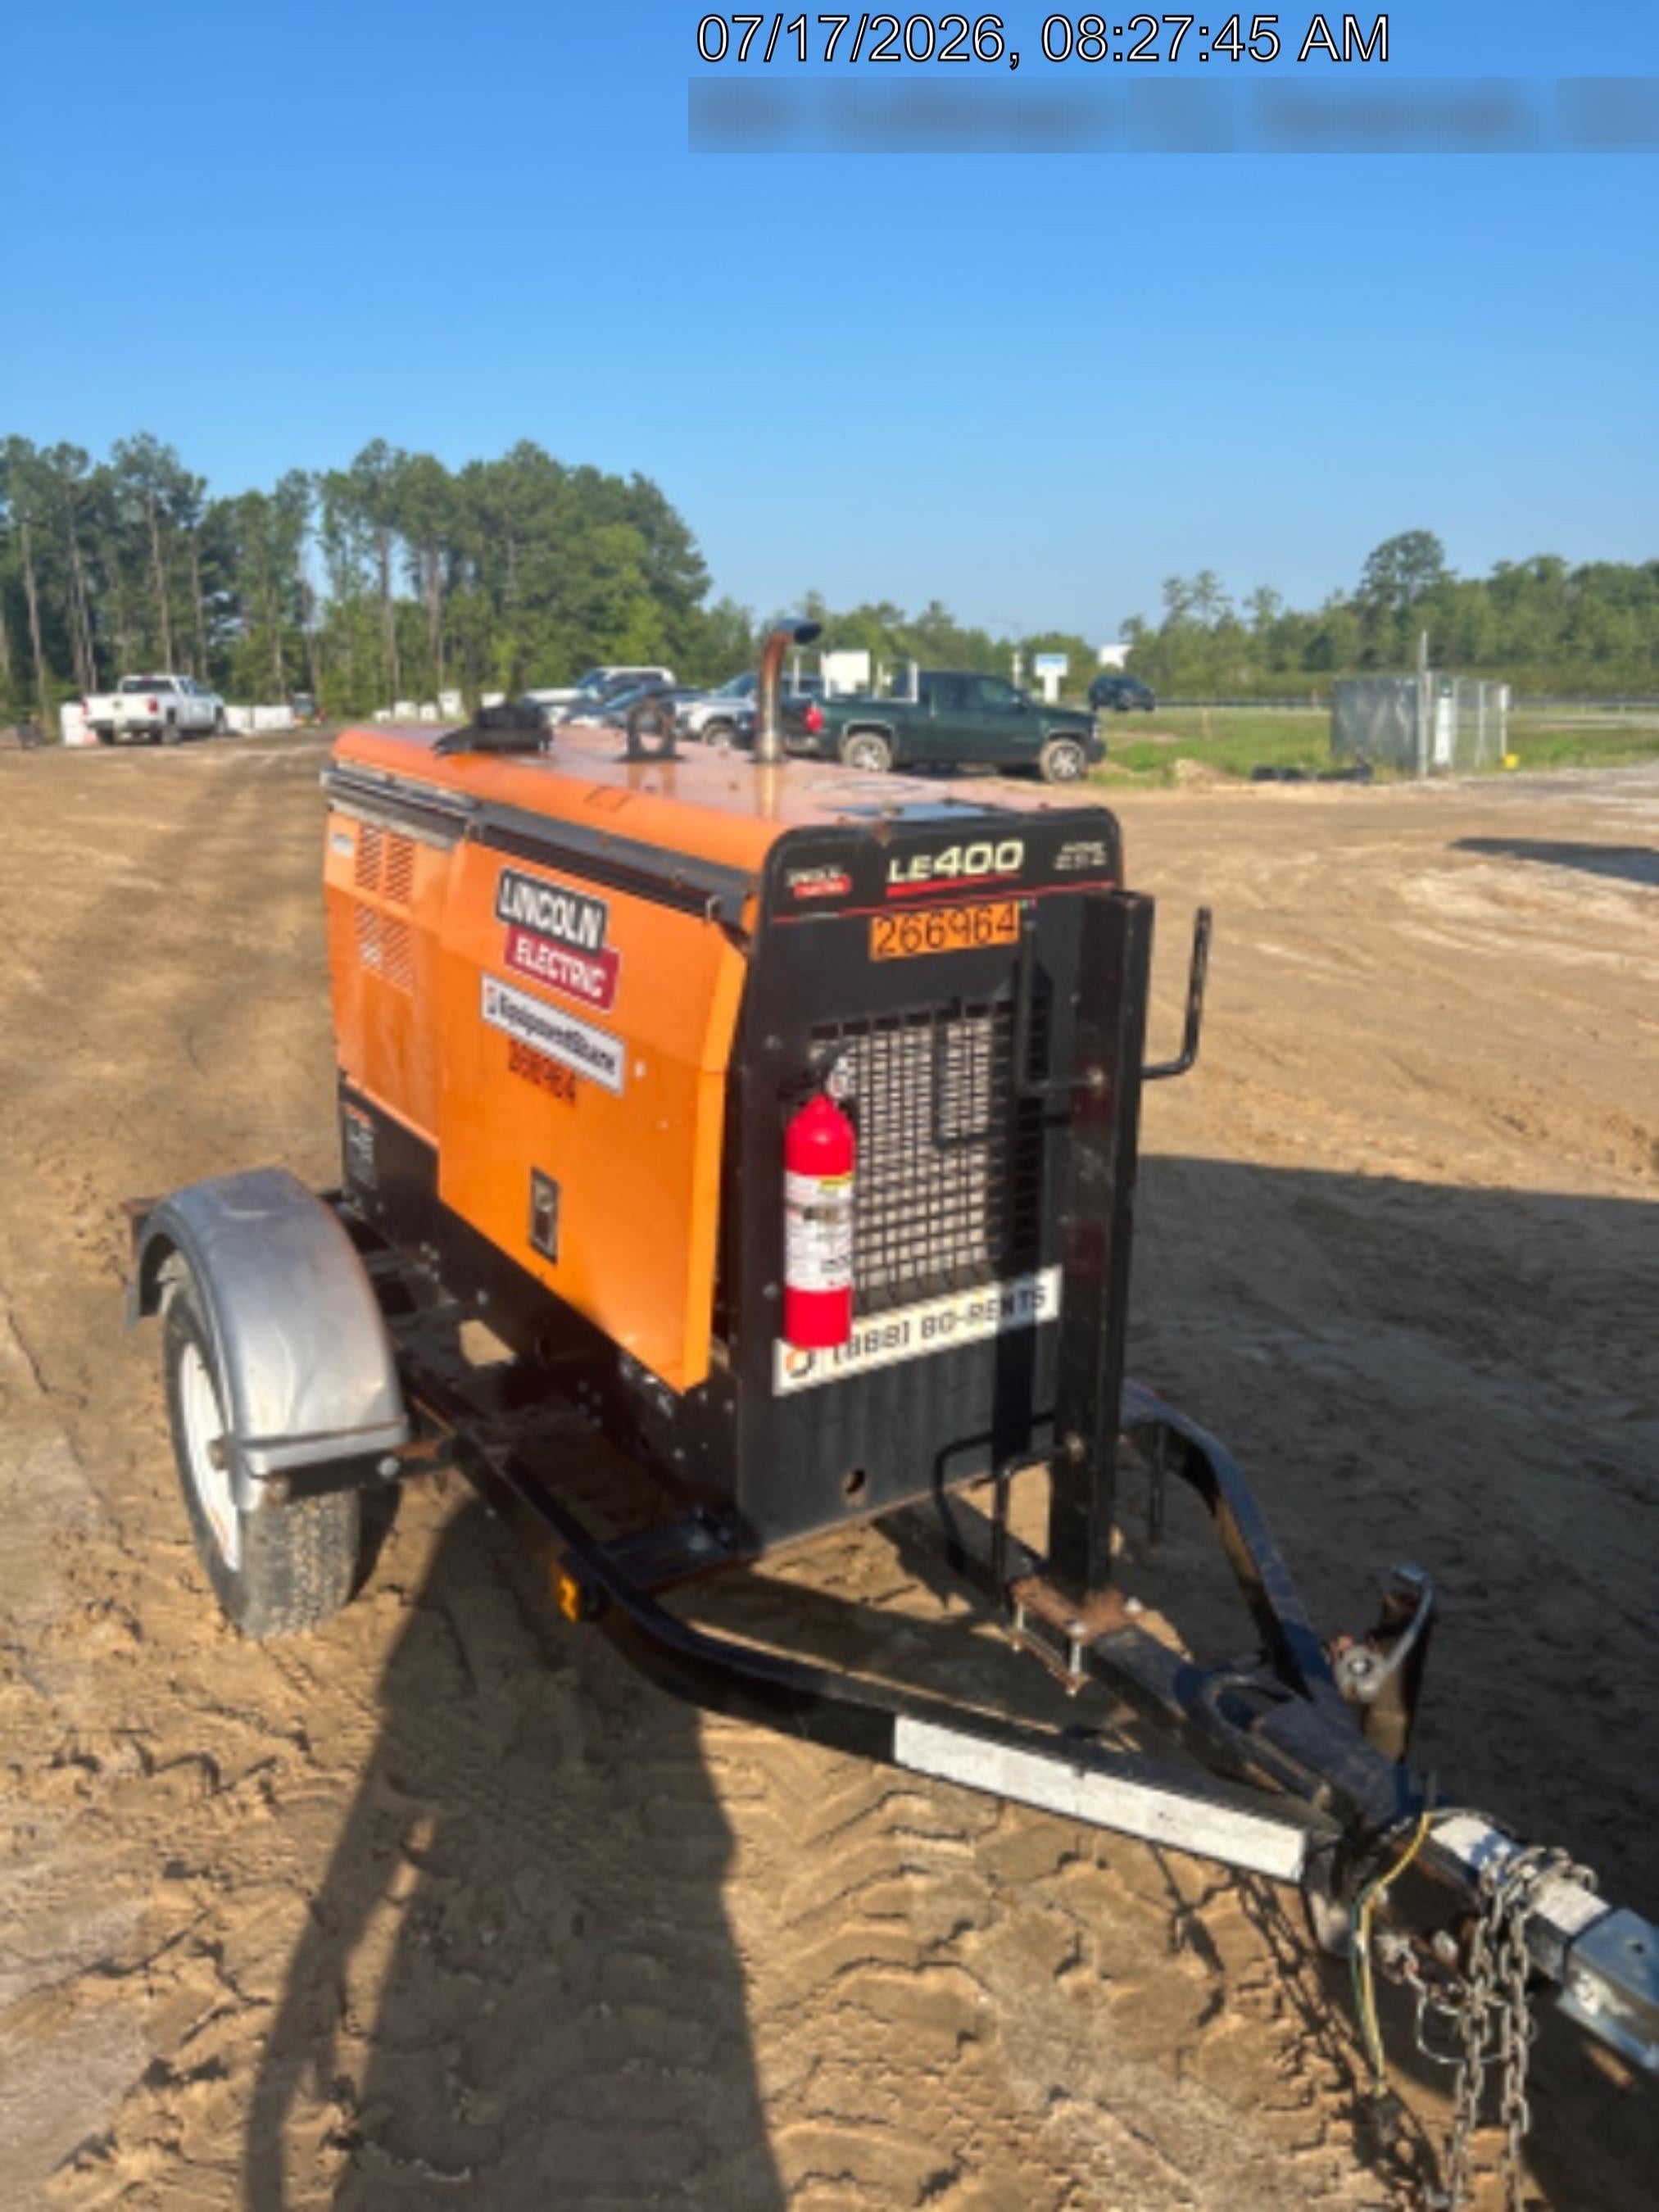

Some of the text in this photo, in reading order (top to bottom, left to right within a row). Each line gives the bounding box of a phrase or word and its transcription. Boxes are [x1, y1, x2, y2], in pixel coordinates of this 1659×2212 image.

[887, 840, 1024, 883] LE400
[500, 876, 603, 949] LINCOLN
[875, 904, 1017, 956] 266964
[514, 934, 608, 999] ELECTRIC
